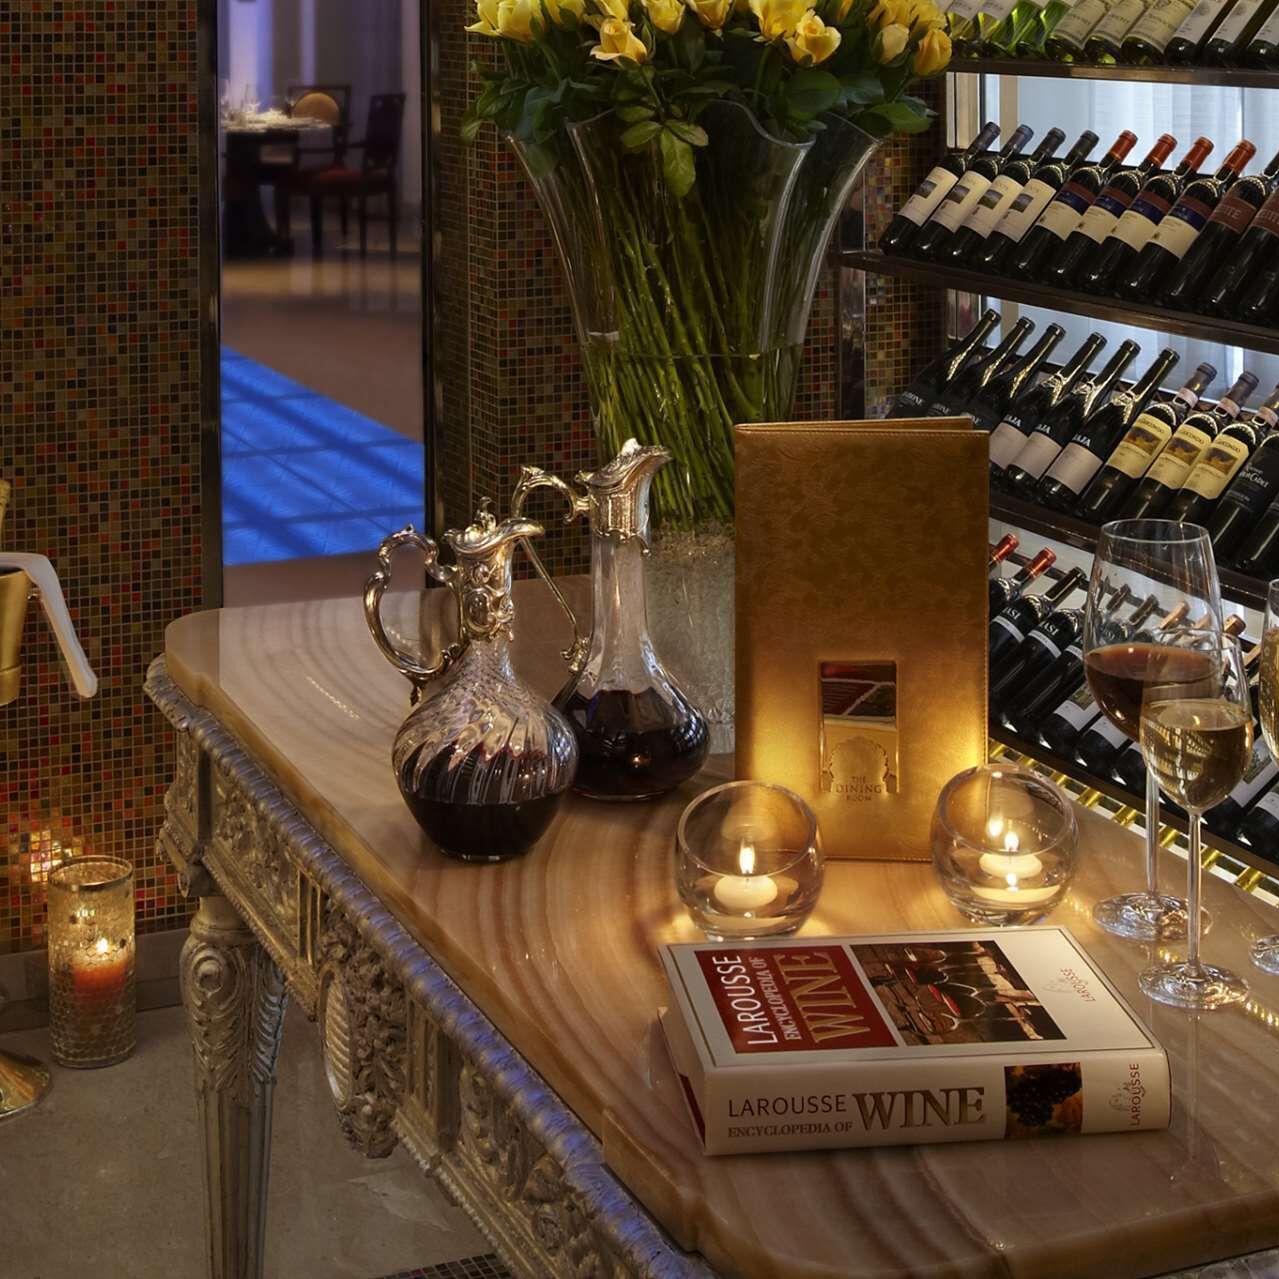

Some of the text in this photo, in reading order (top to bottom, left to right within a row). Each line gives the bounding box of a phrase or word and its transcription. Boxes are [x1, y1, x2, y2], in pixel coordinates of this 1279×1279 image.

[835, 783, 882, 794] DINING
[712, 955, 779, 1046] LAROUSSE
[748, 956, 803, 1041] ENCYCLOPEDIA OF
[773, 951, 871, 1044] WINE
[1060, 967, 1097, 1003] LAROUSSE
[728, 1086, 985, 1131] LAROUSSE WINE
[1128, 1063, 1144, 1127] LAROUSSE
[727, 1121, 853, 1138] ENCYCLOPEDIA OF
